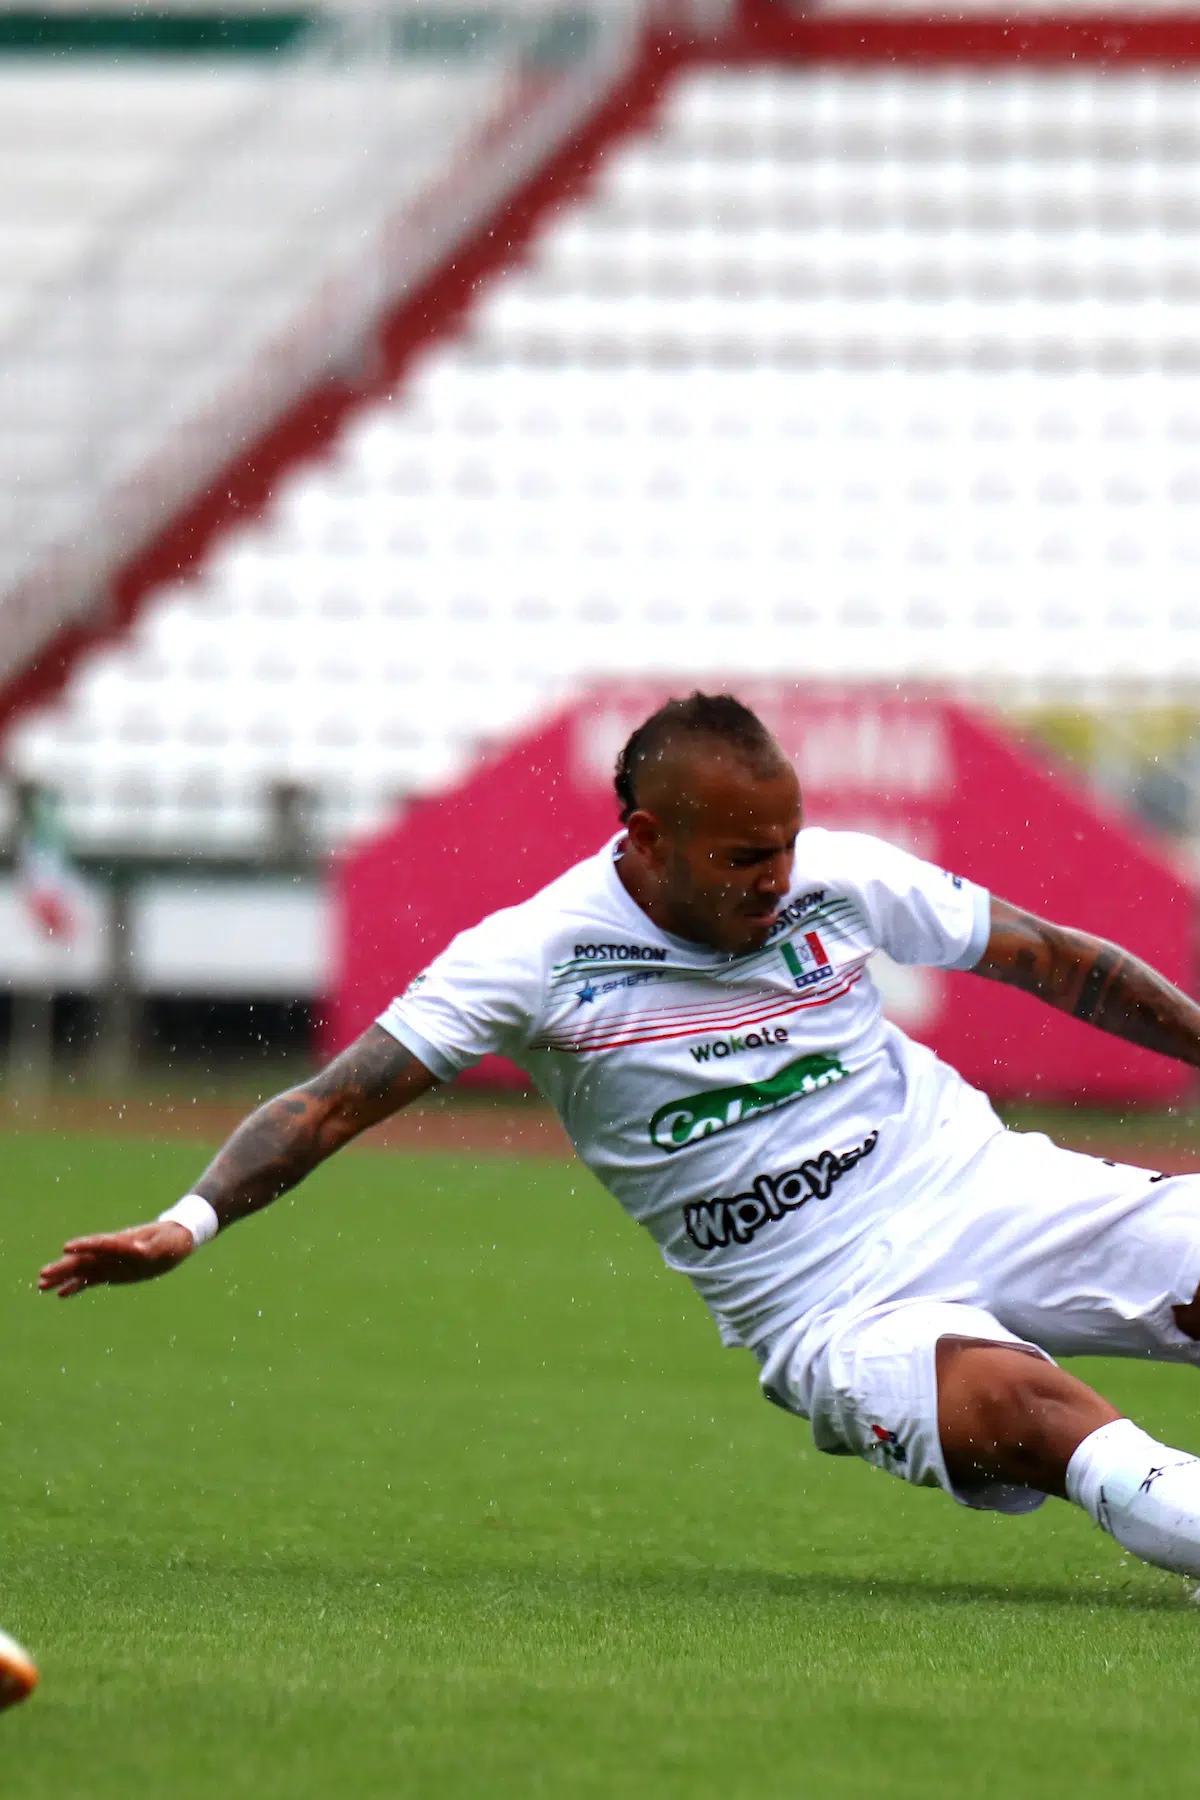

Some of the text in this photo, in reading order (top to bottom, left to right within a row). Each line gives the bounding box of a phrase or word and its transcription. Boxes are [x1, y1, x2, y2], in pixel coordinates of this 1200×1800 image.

[767, 890, 826, 937] OSTOBON
[574, 944, 667, 961] POSTOBON
[690, 1027, 789, 1063] wakate
